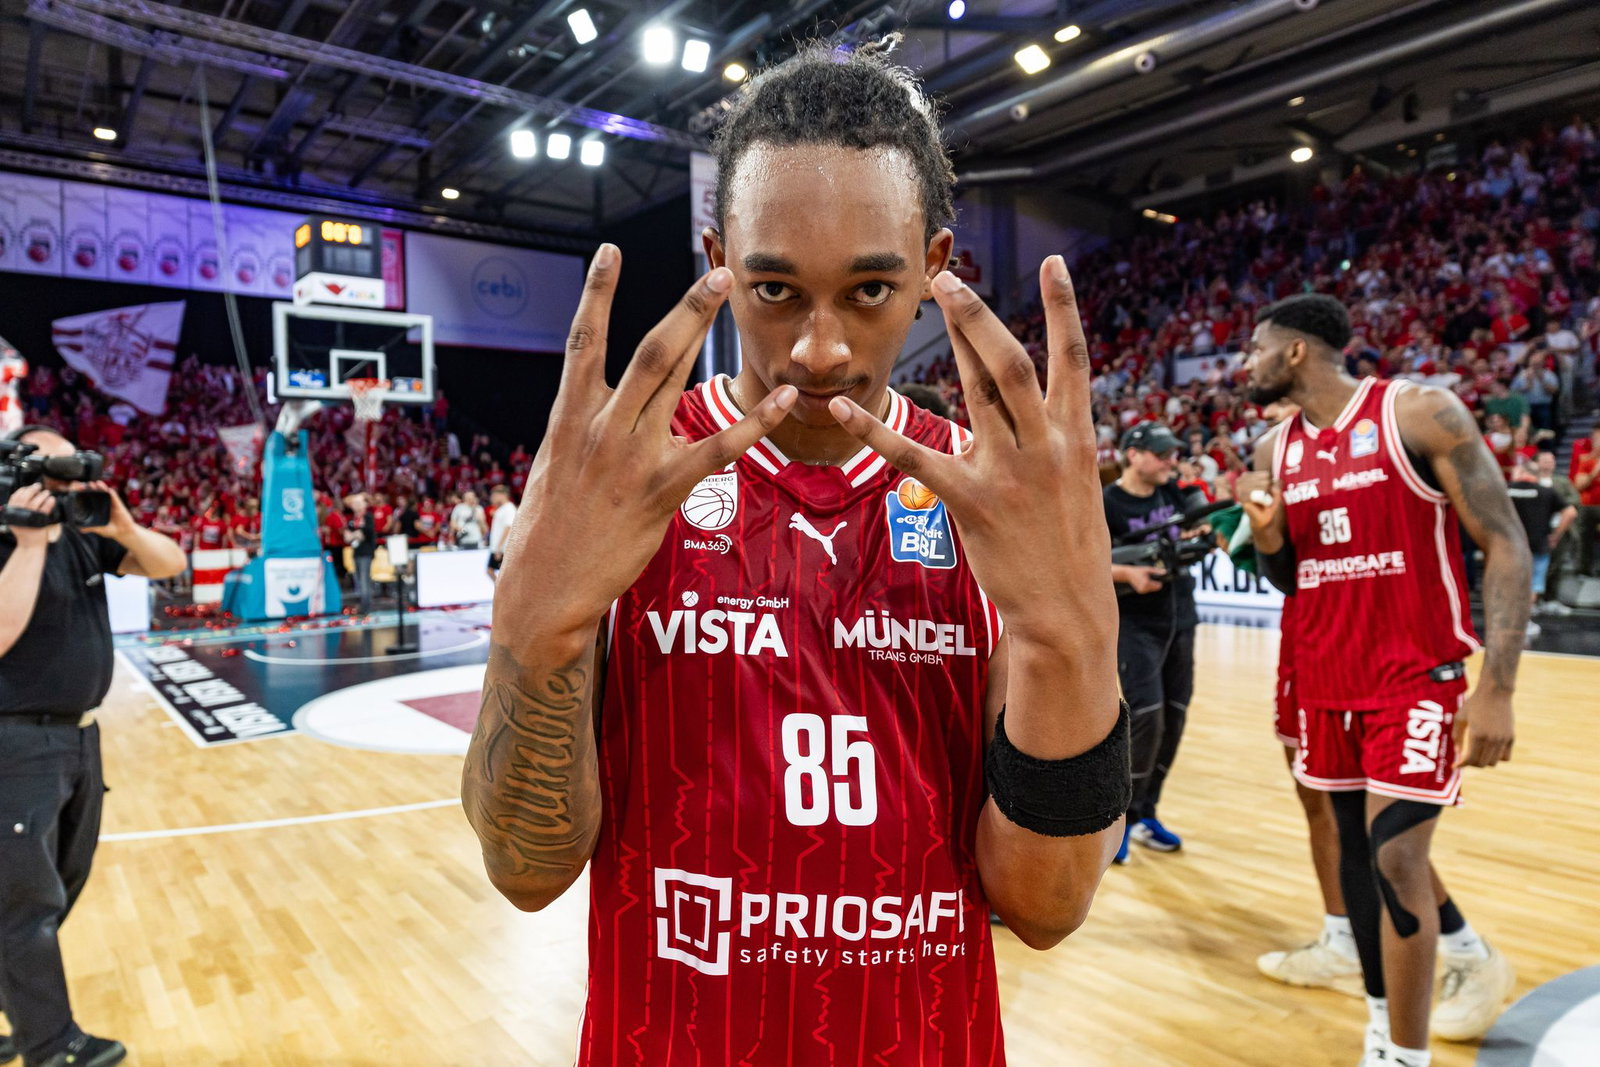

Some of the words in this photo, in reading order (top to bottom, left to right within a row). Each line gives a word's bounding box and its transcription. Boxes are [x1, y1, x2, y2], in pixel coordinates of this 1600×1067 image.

[1318, 507, 1352, 545] 35
[684, 539, 727, 551] BMA365
[900, 532, 946, 559] BBL
[717, 595, 754, 609] energy
[756, 596, 789, 608] GmbH
[646, 608, 789, 658] VISTA
[833, 609, 977, 656] MÜNDEL
[868, 649, 907, 663] TRANS
[909, 652, 944, 666] GMBH
[781, 712, 878, 826] 85
[740, 942, 829, 967] safety
[841, 947, 915, 967] starts
